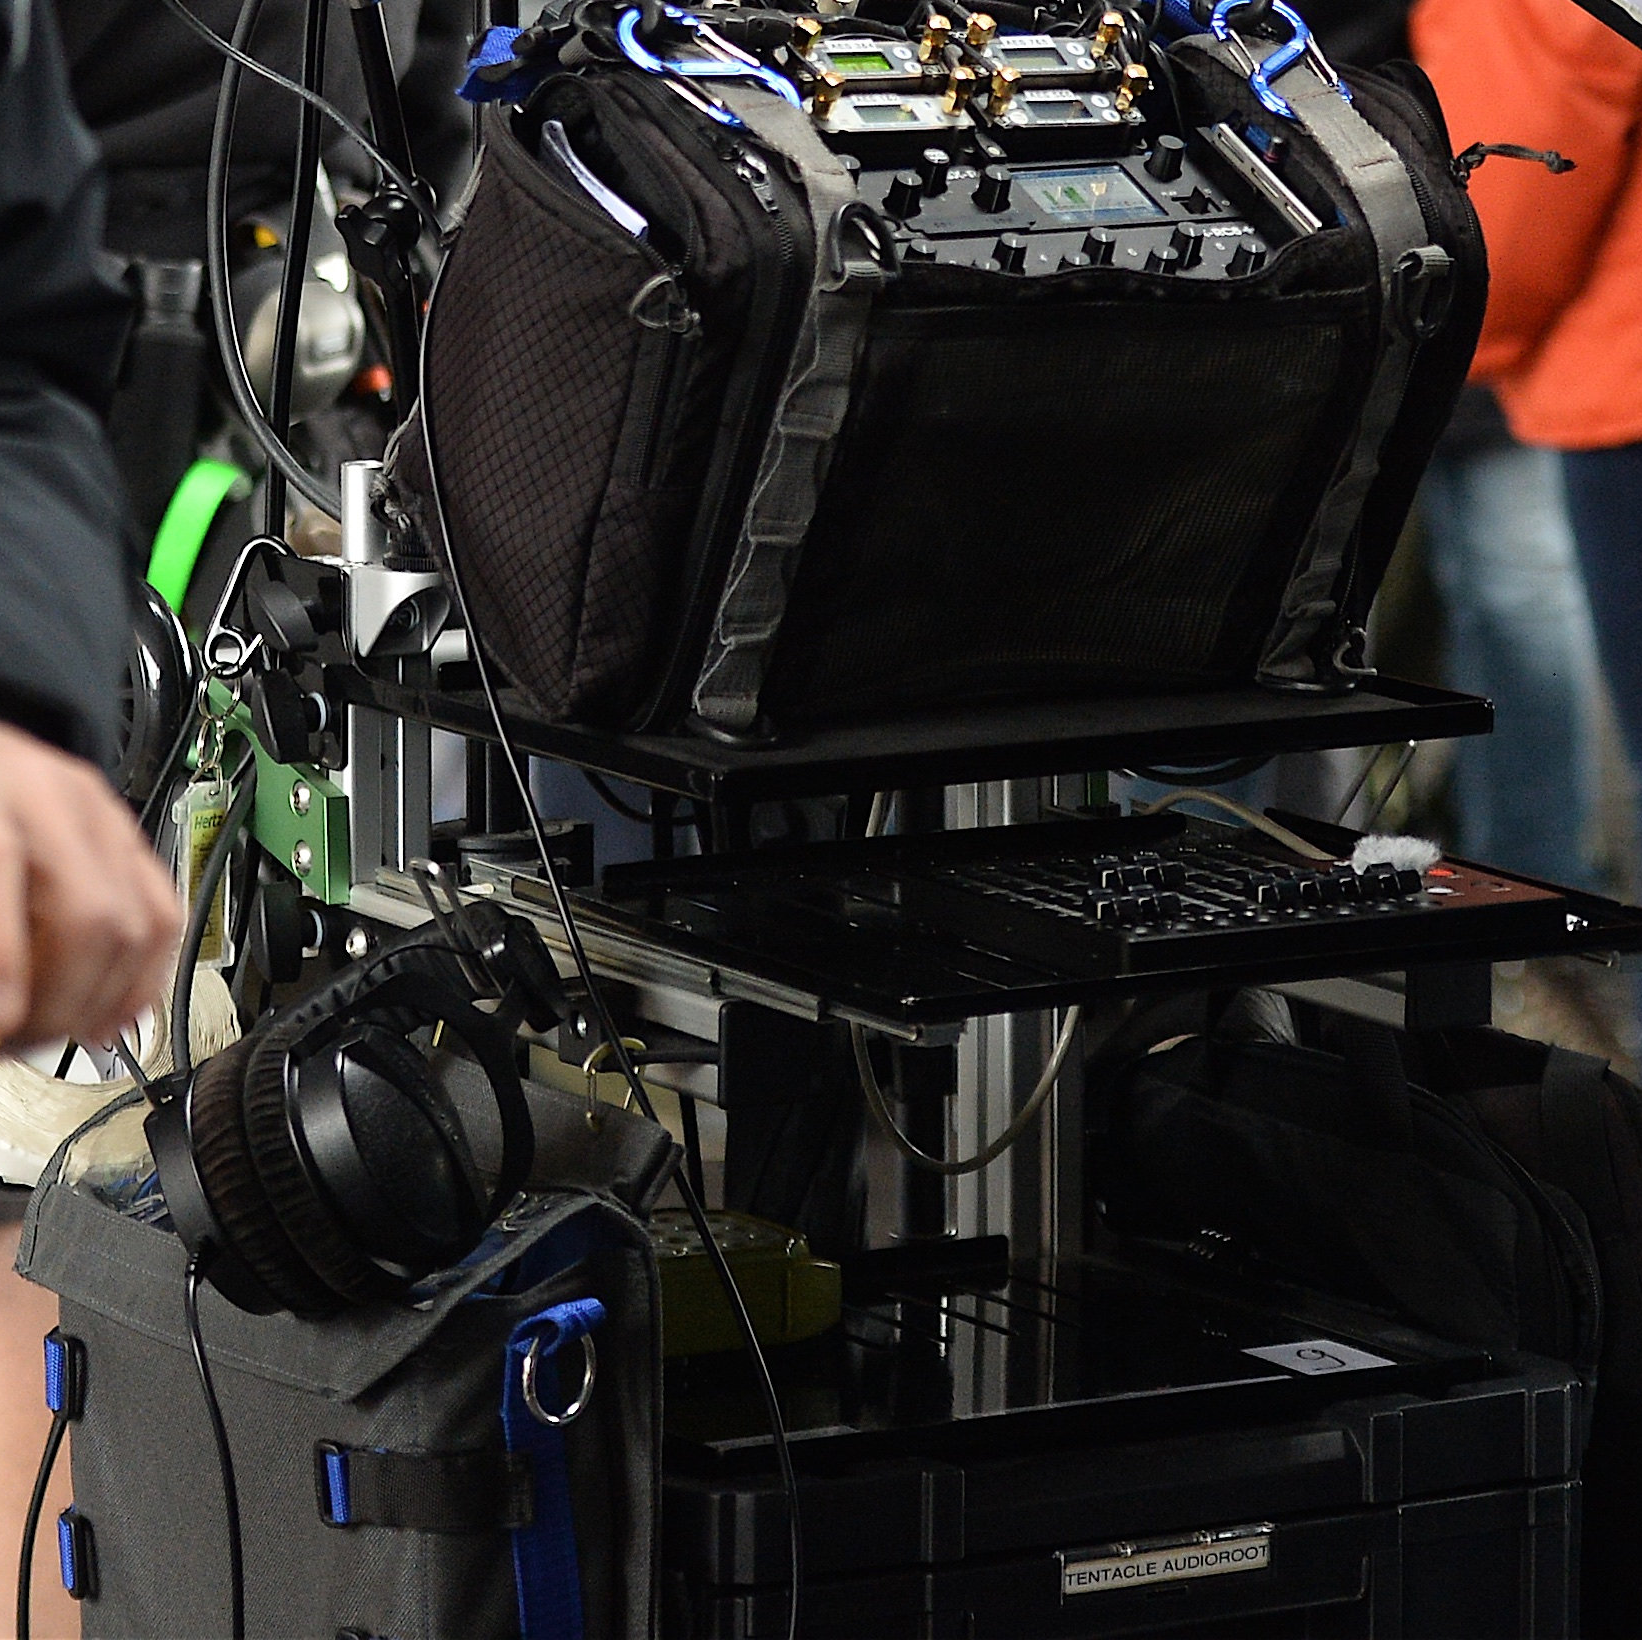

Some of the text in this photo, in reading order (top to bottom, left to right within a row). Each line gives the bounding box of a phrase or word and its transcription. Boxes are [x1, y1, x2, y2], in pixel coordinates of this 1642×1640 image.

[194, 814, 223, 829] Hertz
[1067, 1545, 1269, 1587] TENTACLE AUDIOROOT
